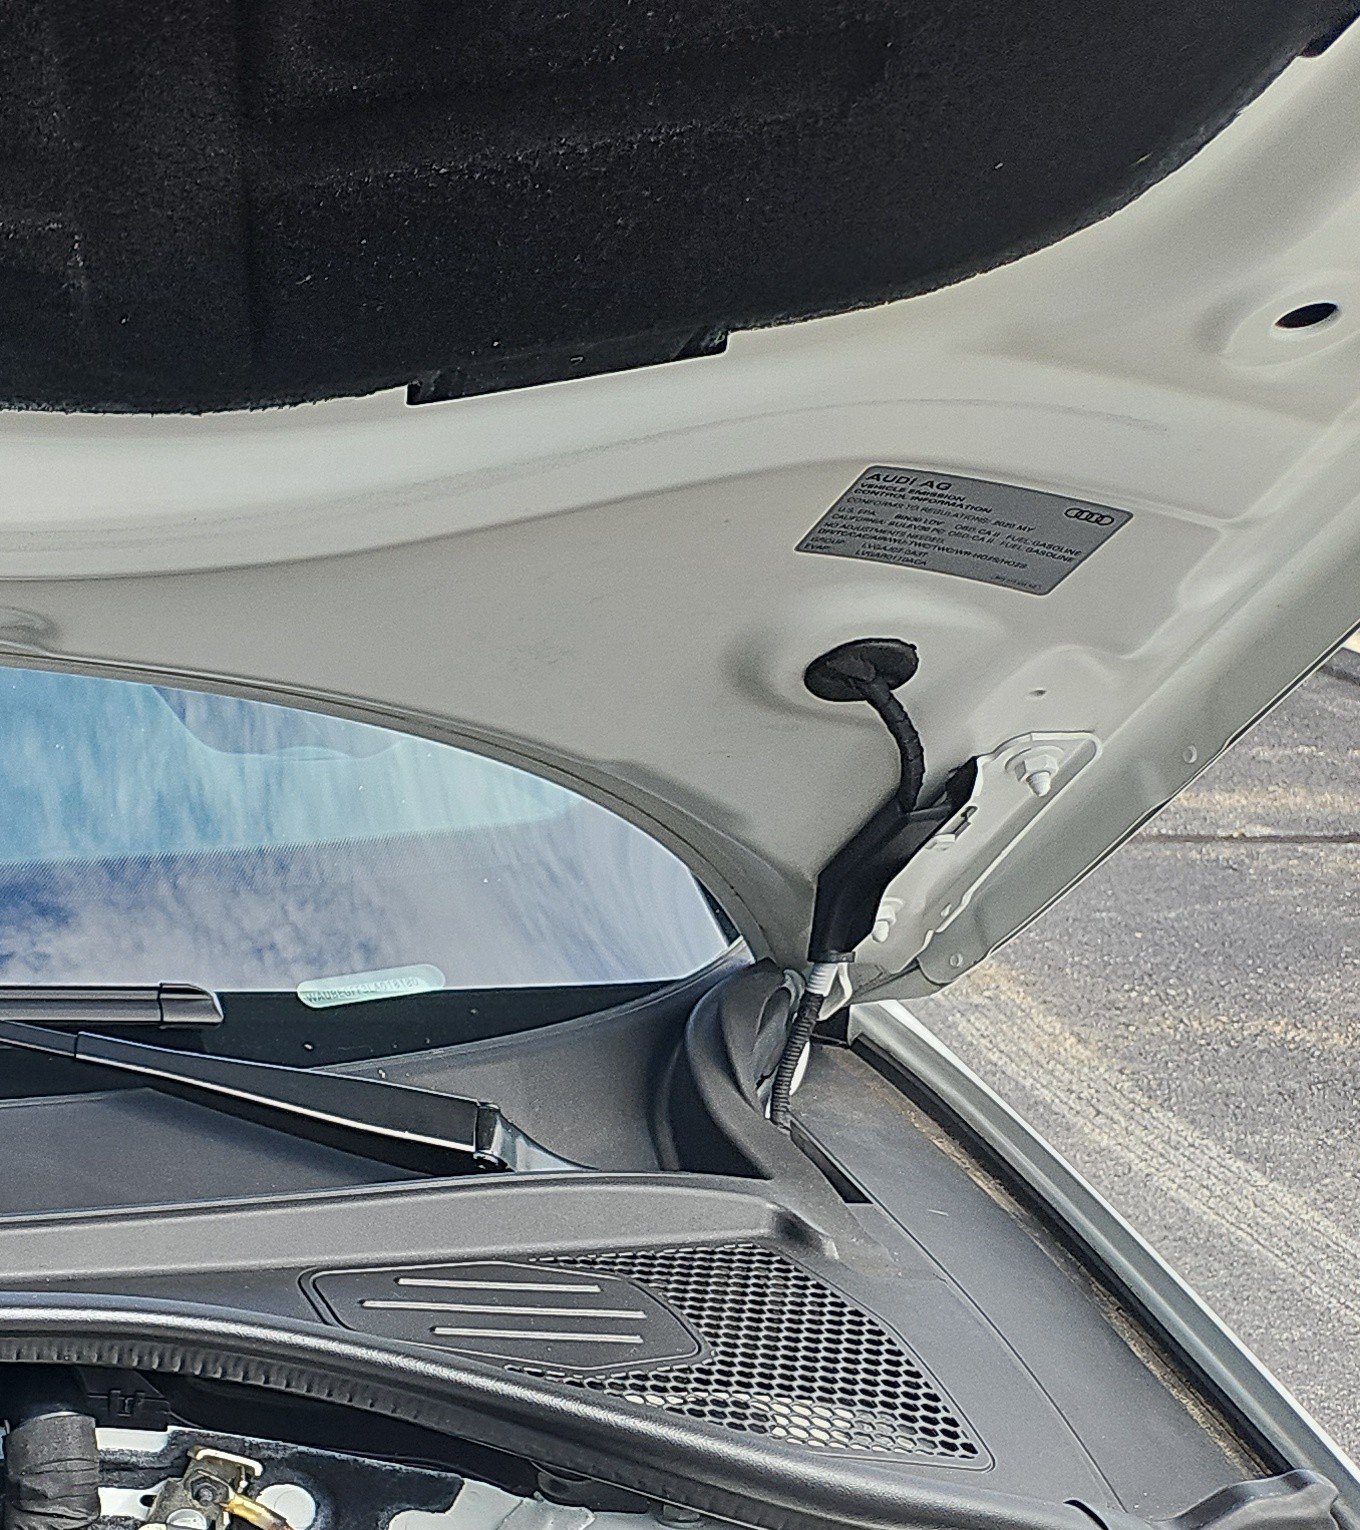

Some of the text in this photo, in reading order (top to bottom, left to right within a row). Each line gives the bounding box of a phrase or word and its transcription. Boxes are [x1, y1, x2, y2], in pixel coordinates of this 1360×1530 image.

[860, 482, 967, 502] VEHICLE EMISSION
[865, 473, 953, 491] AUDI AG
[853, 488, 993, 514] CONTROL INFORMATION
